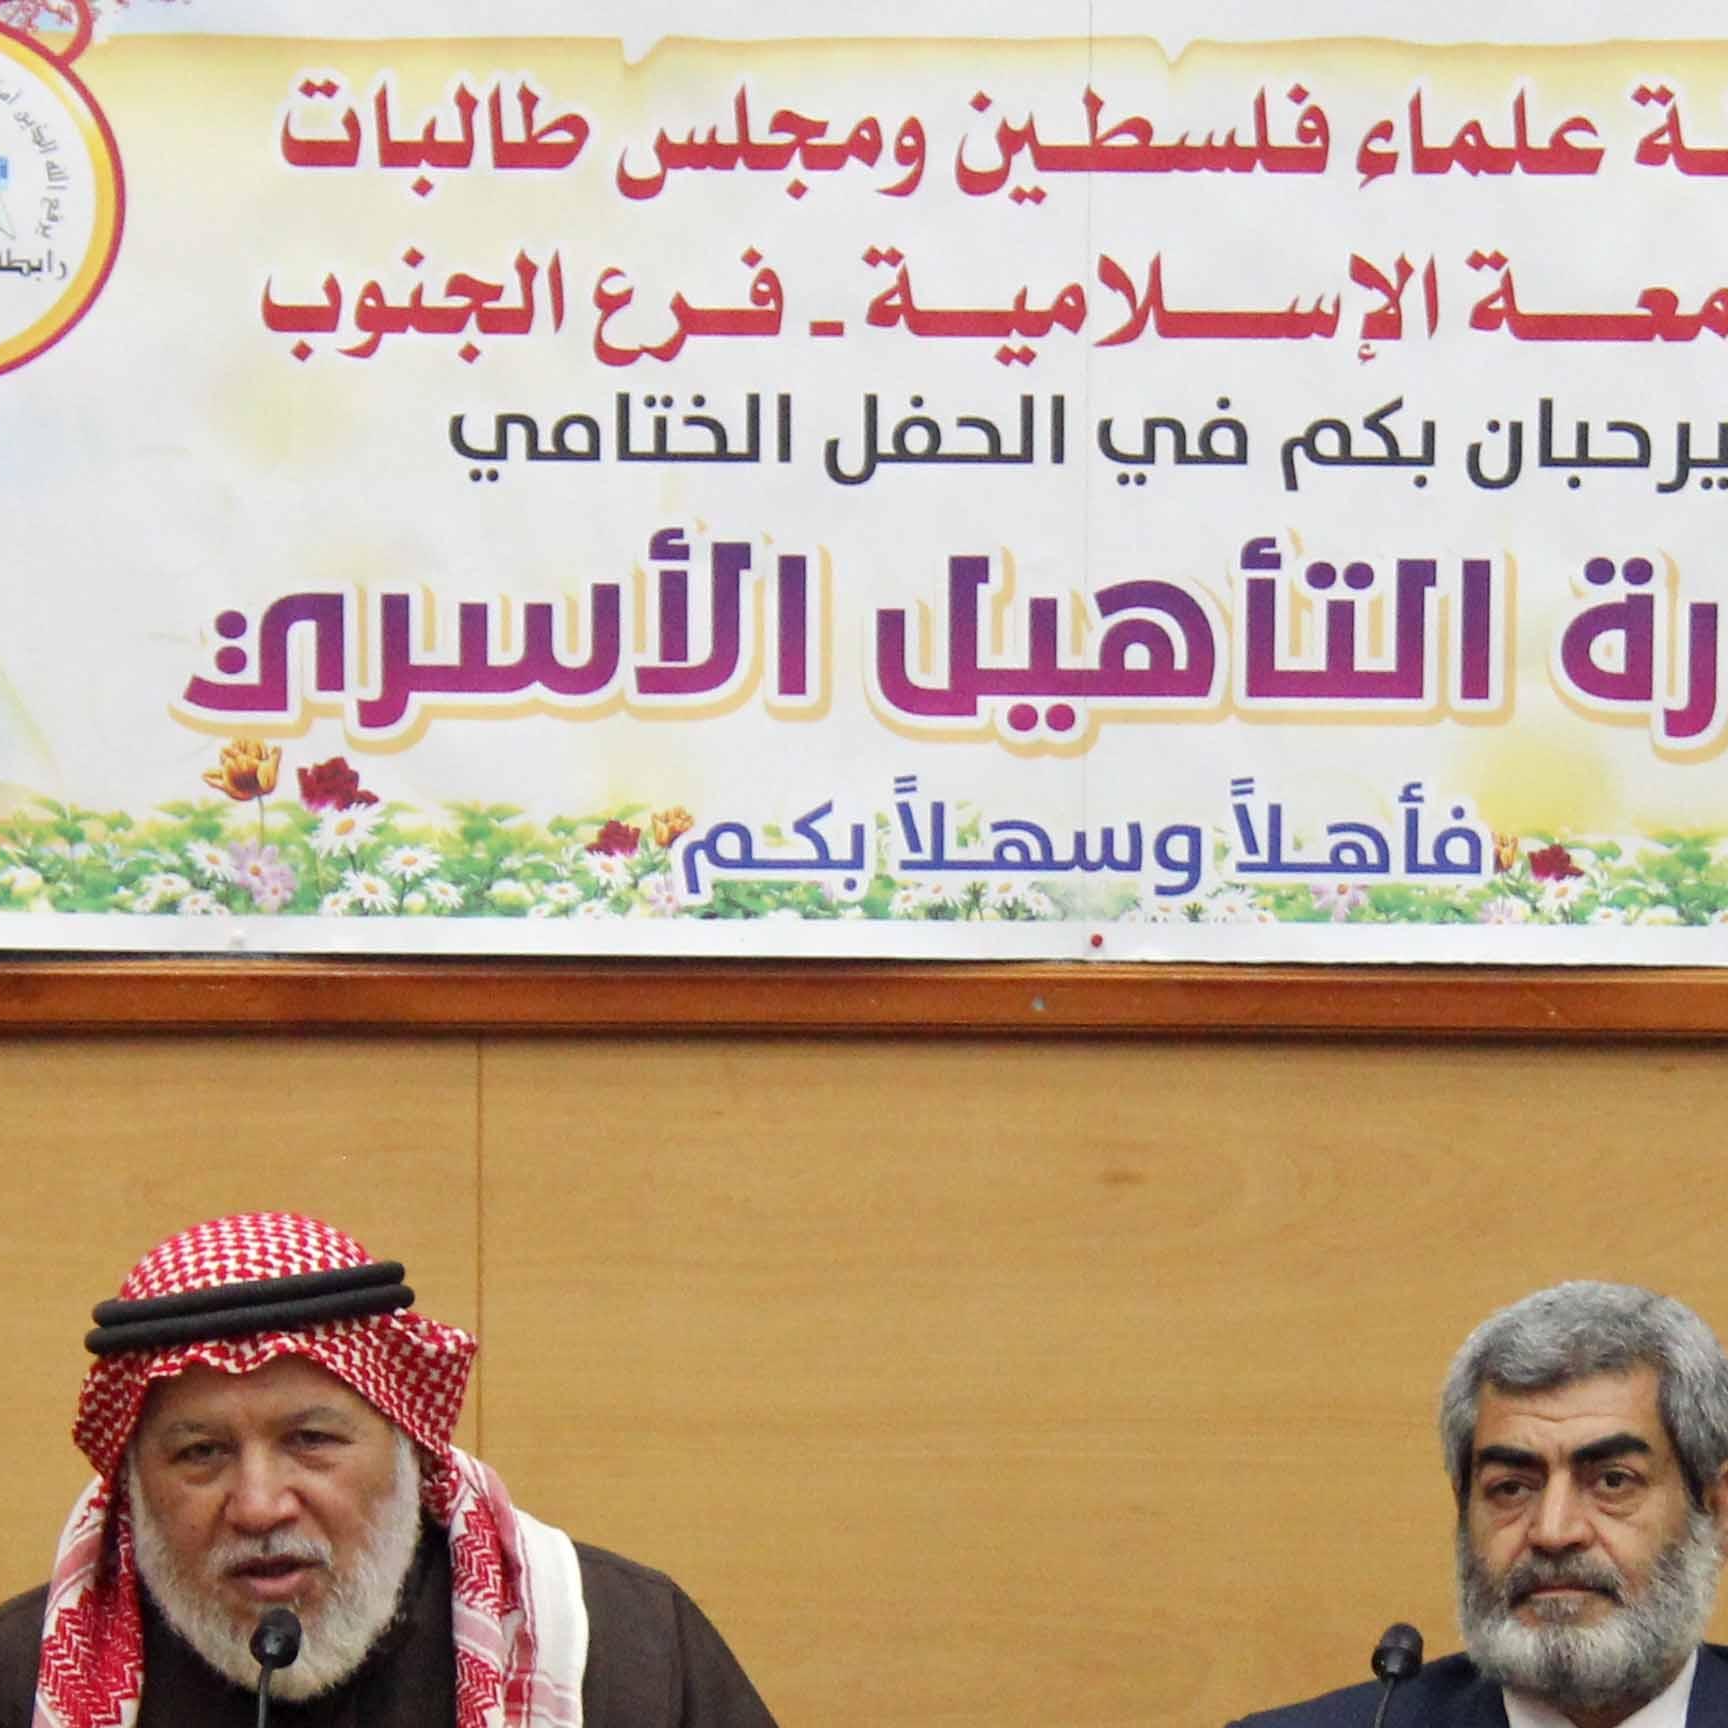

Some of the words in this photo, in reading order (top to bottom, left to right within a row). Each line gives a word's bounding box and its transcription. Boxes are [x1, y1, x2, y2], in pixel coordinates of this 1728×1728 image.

[284, 83, 589, 194] طالبات
[619, 93, 925, 198] ومجلس
[958, 87, 1328, 202] فلسطين
[1359, 97, 1604, 188] علماء
[264, 251, 564, 361] الجنوب
[596, 251, 783, 365] فرع
[866, 250, 1437, 363] الإسلامية
[451, 394, 790, 481] الختامي
[826, 395, 1064, 484] الحفل
[1099, 399, 1247, 484] في
[1283, 398, 1435, 490] بكم
[187, 530, 805, 727] الأسري
[879, 539, 1489, 731] التأهيل
[685, 805, 863, 893] بكم
[896, 778, 1201, 895] وسهلاً
[1233, 780, 1481, 873] فأهلاً
